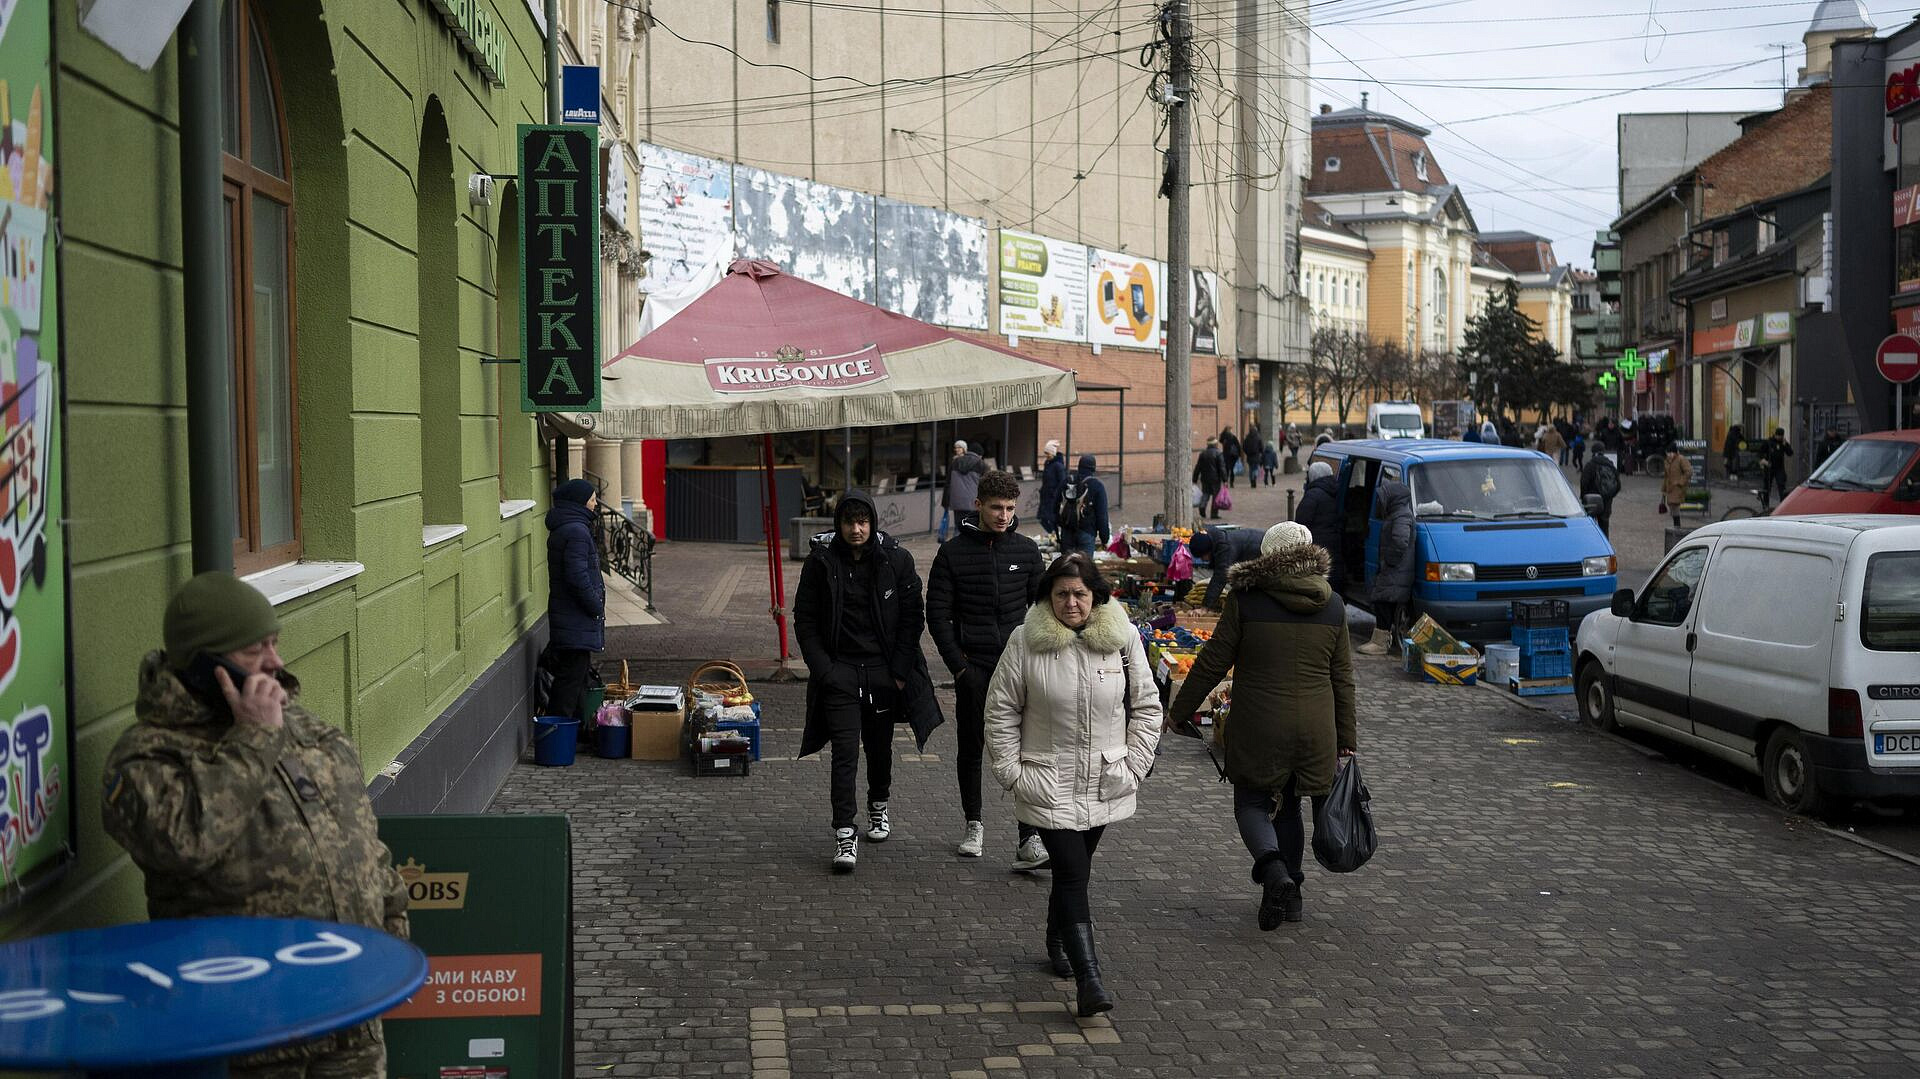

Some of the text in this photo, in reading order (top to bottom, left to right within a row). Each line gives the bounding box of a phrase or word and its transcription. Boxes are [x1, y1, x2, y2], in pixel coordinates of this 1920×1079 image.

[534, 134, 583, 396] АПТЕКА
[716, 359, 876, 385] KRUŠOVICE
[599, 407, 667, 435] ЧРЕЗМЕРНОЕ
[673, 404, 752, 434] УПОТРЕБЛЕНИЕ
[760, 398, 833, 430] АЛКОГОЛЬНОЙ
[900, 391, 938, 420] ВРЕДИТ
[944, 385, 985, 415] ВАШЕМУ
[991, 381, 1042, 410] ЗДОРОВЬЮ
[581, 418, 590, 426] 18
[1886, 735, 1920, 752] DCD
[405, 881, 460, 901] OBS
[471, 969, 517, 985] КАВУ
[452, 987, 526, 1004] СОБОЮ!
